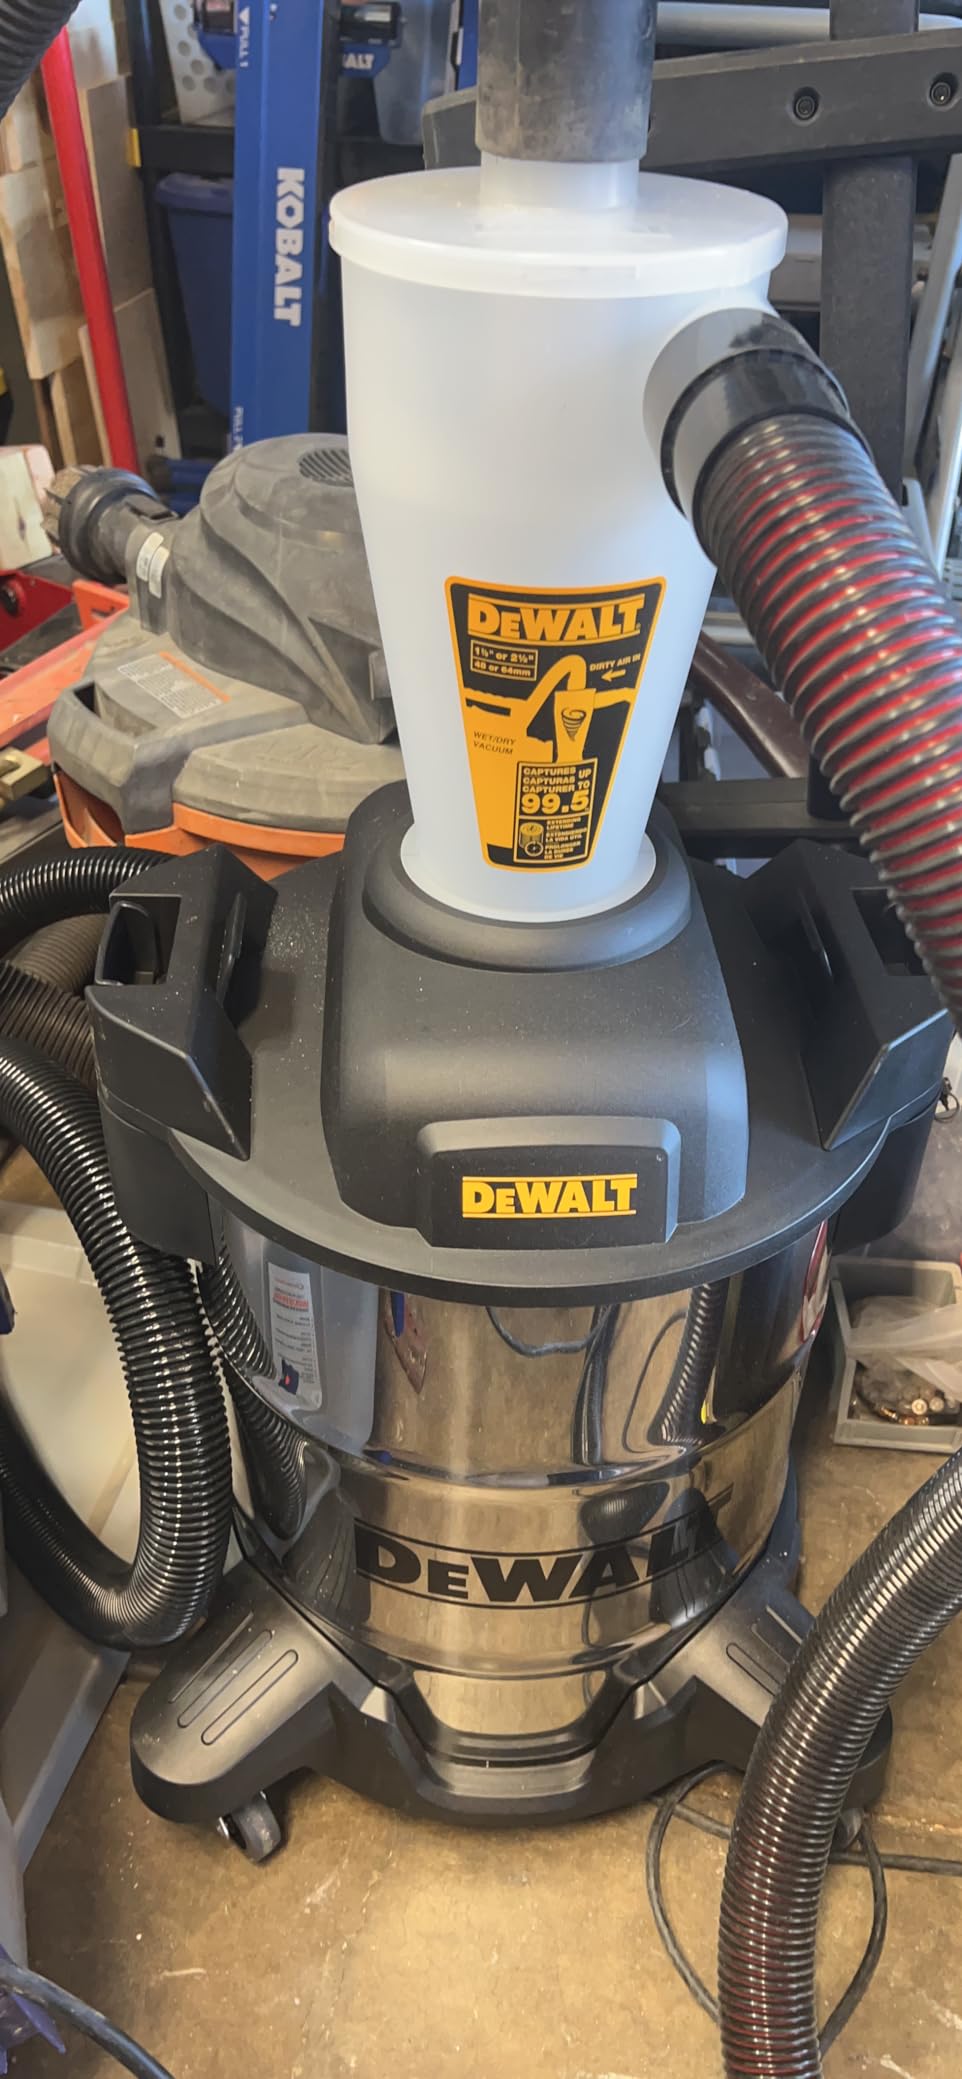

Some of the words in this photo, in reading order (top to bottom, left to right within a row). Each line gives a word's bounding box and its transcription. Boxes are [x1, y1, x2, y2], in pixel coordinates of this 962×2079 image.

[342, 53, 374, 69] ALT
[274, 167, 305, 327] KOBALT
[467, 596, 645, 643] DEWALT
[488, 664, 499, 673] or
[590, 660, 616, 672] DIRTY
[616, 656, 631, 667] AIR
[473, 730, 516, 745] WET/DRY
[473, 740, 513, 755] VACUUM
[523, 767, 576, 776] CAPTURES
[578, 768, 592, 779] UP
[522, 775, 576, 785] CAPTURAS
[577, 780, 590, 790] TO
[522, 784, 576, 794] CAPTURER
[463, 1177, 637, 1215] DEWALT
